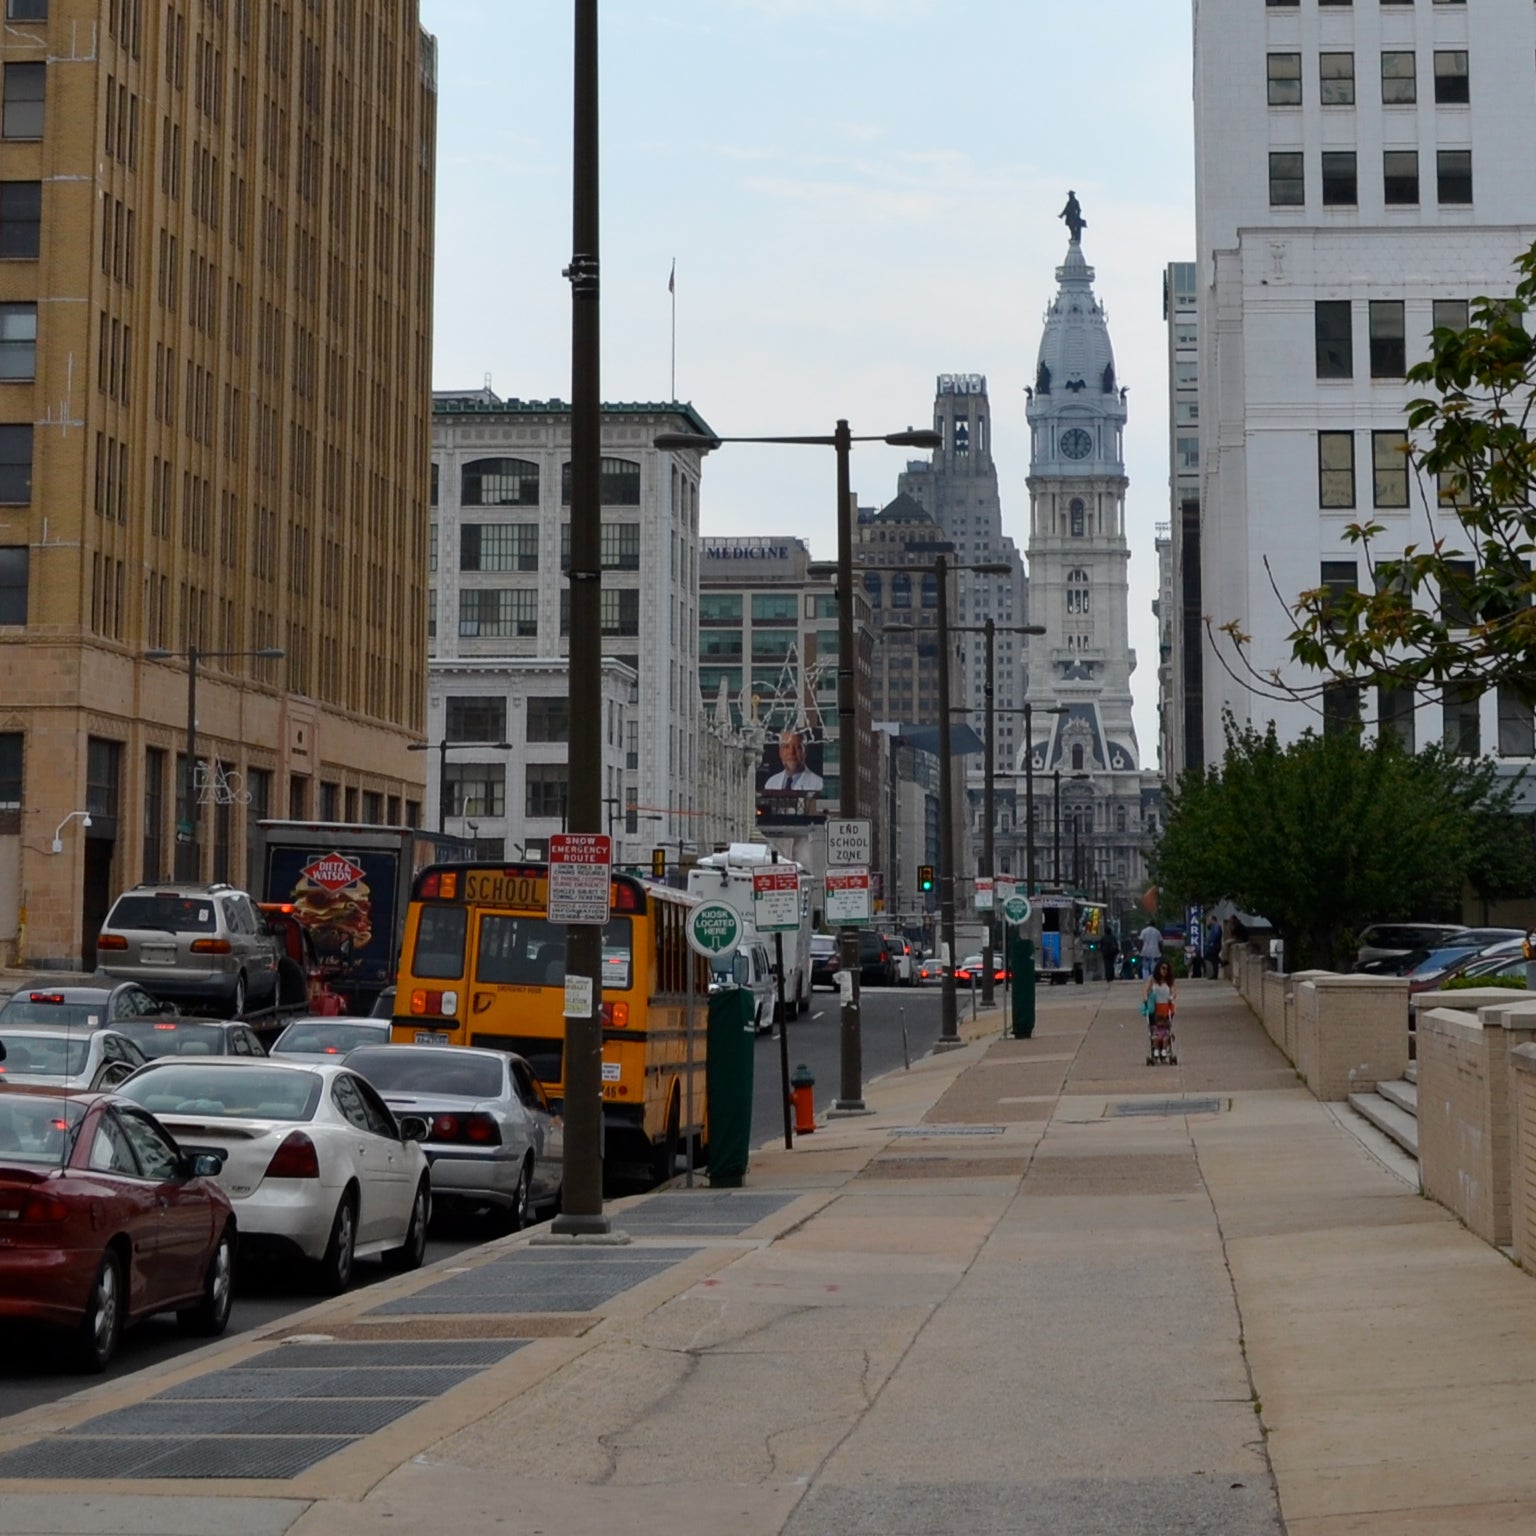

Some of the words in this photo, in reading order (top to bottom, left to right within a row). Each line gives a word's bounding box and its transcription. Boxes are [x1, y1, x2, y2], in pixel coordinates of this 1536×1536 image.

[839, 825, 859, 834] END
[565, 837, 596, 845] SNOW
[830, 838, 868, 847] SCHOOL
[551, 845, 609, 854] EMERGENCY
[563, 854, 596, 862] ROUTE
[836, 850, 862, 860] ZONE
[319, 861, 343, 871] DIETZ
[312, 870, 352, 881] WATSON
[467, 875, 540, 903] SCHOOL
[701, 911, 728, 919] KIOSK
[696, 919, 735, 927] LOCATED
[1190, 905, 1200, 946] PARK
[704, 927, 727, 935] HERE
